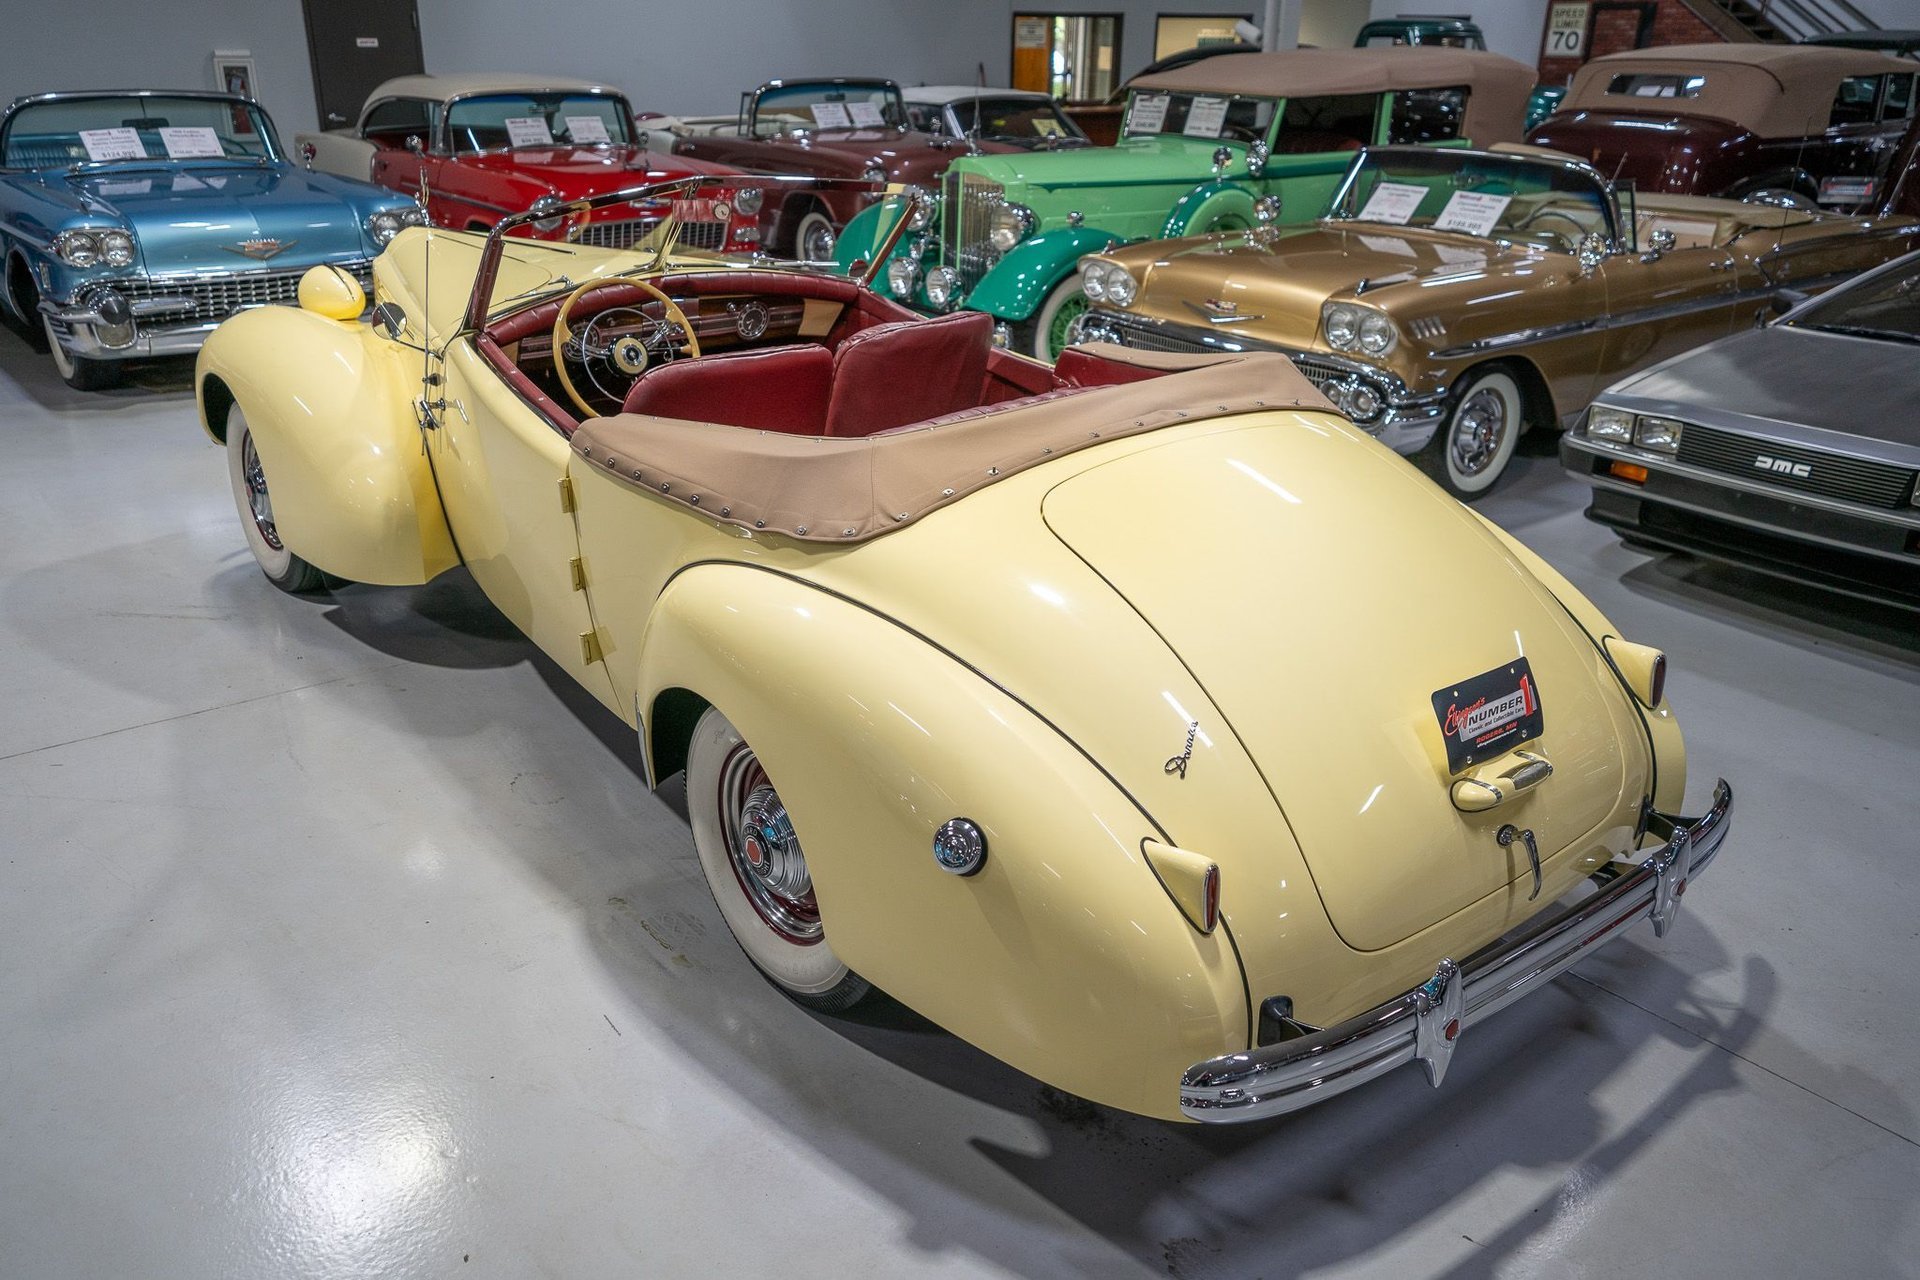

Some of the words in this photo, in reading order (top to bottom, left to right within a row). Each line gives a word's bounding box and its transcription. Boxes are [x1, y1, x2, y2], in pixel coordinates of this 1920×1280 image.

[1554, 8, 1585, 17] SPEED
[1555, 20, 1582, 28] LIMIT
[1552, 31, 1580, 50] 70
[1754, 455, 1812, 478] DMC
[1468, 696, 1523, 725] NUMBER
[1520, 673, 1533, 717] 1
